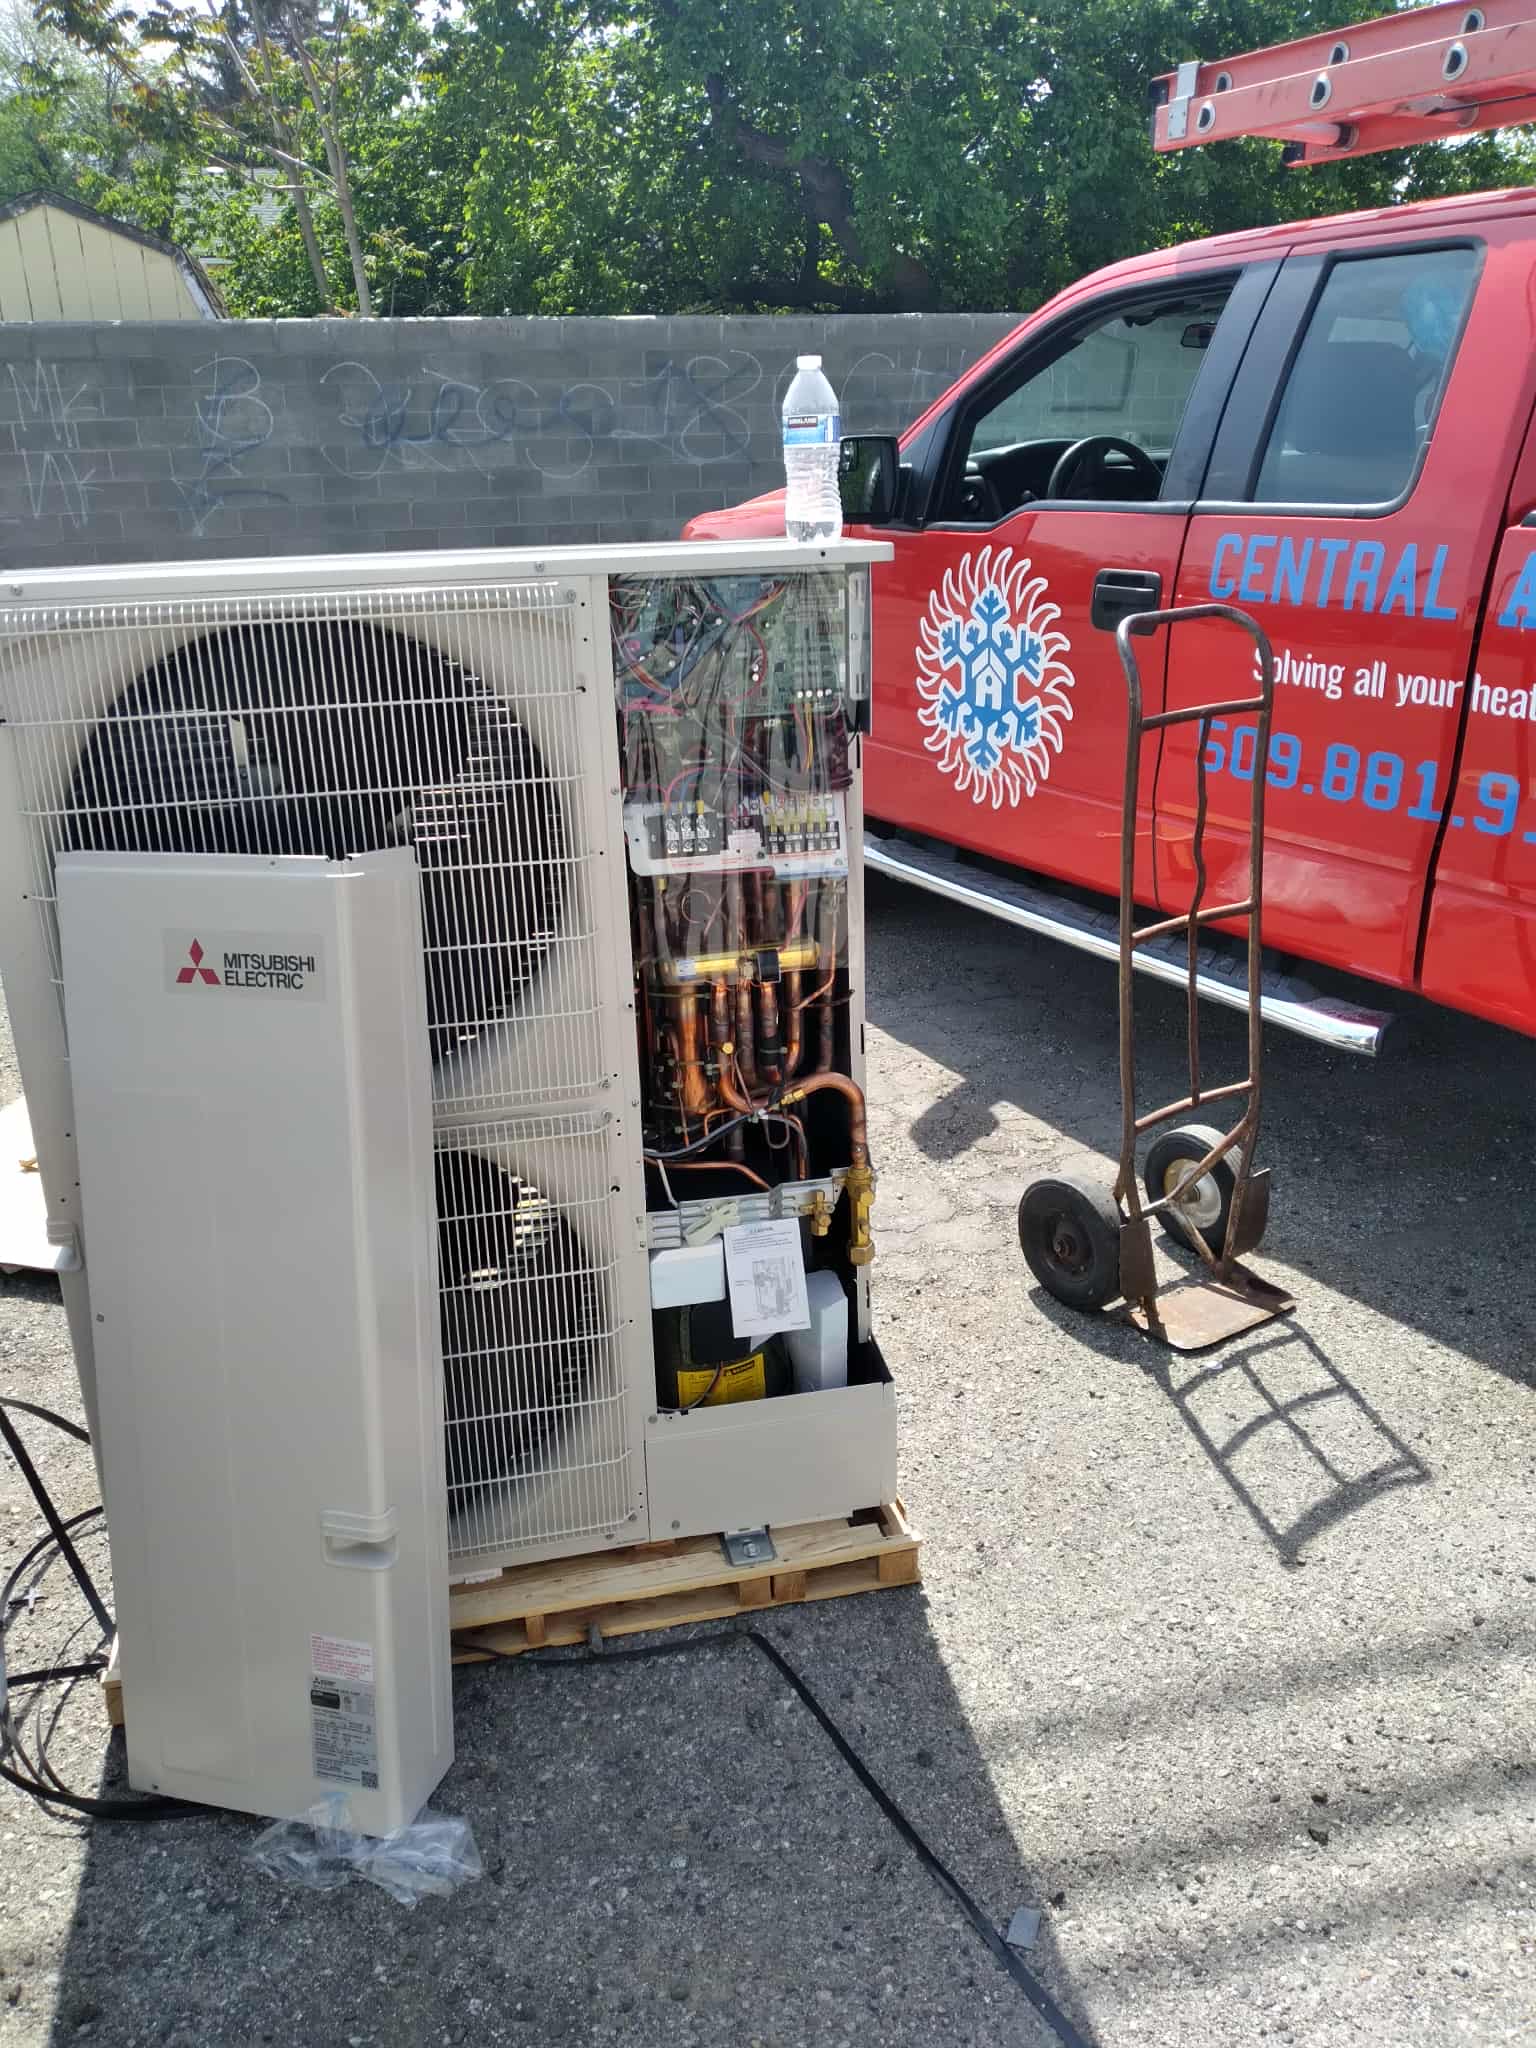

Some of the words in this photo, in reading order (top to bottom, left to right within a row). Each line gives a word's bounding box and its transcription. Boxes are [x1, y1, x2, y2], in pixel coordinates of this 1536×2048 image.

[1209, 532, 1457, 621] CENTRAL
[1252, 648, 1345, 700] Solving
[1353, 660, 1387, 699] all
[1394, 674, 1464, 708] your
[1198, 717, 1536, 845] 509.881.9
[223, 952, 316, 973] MITSUBISHI
[224, 969, 304, 990] ELECTRIC
